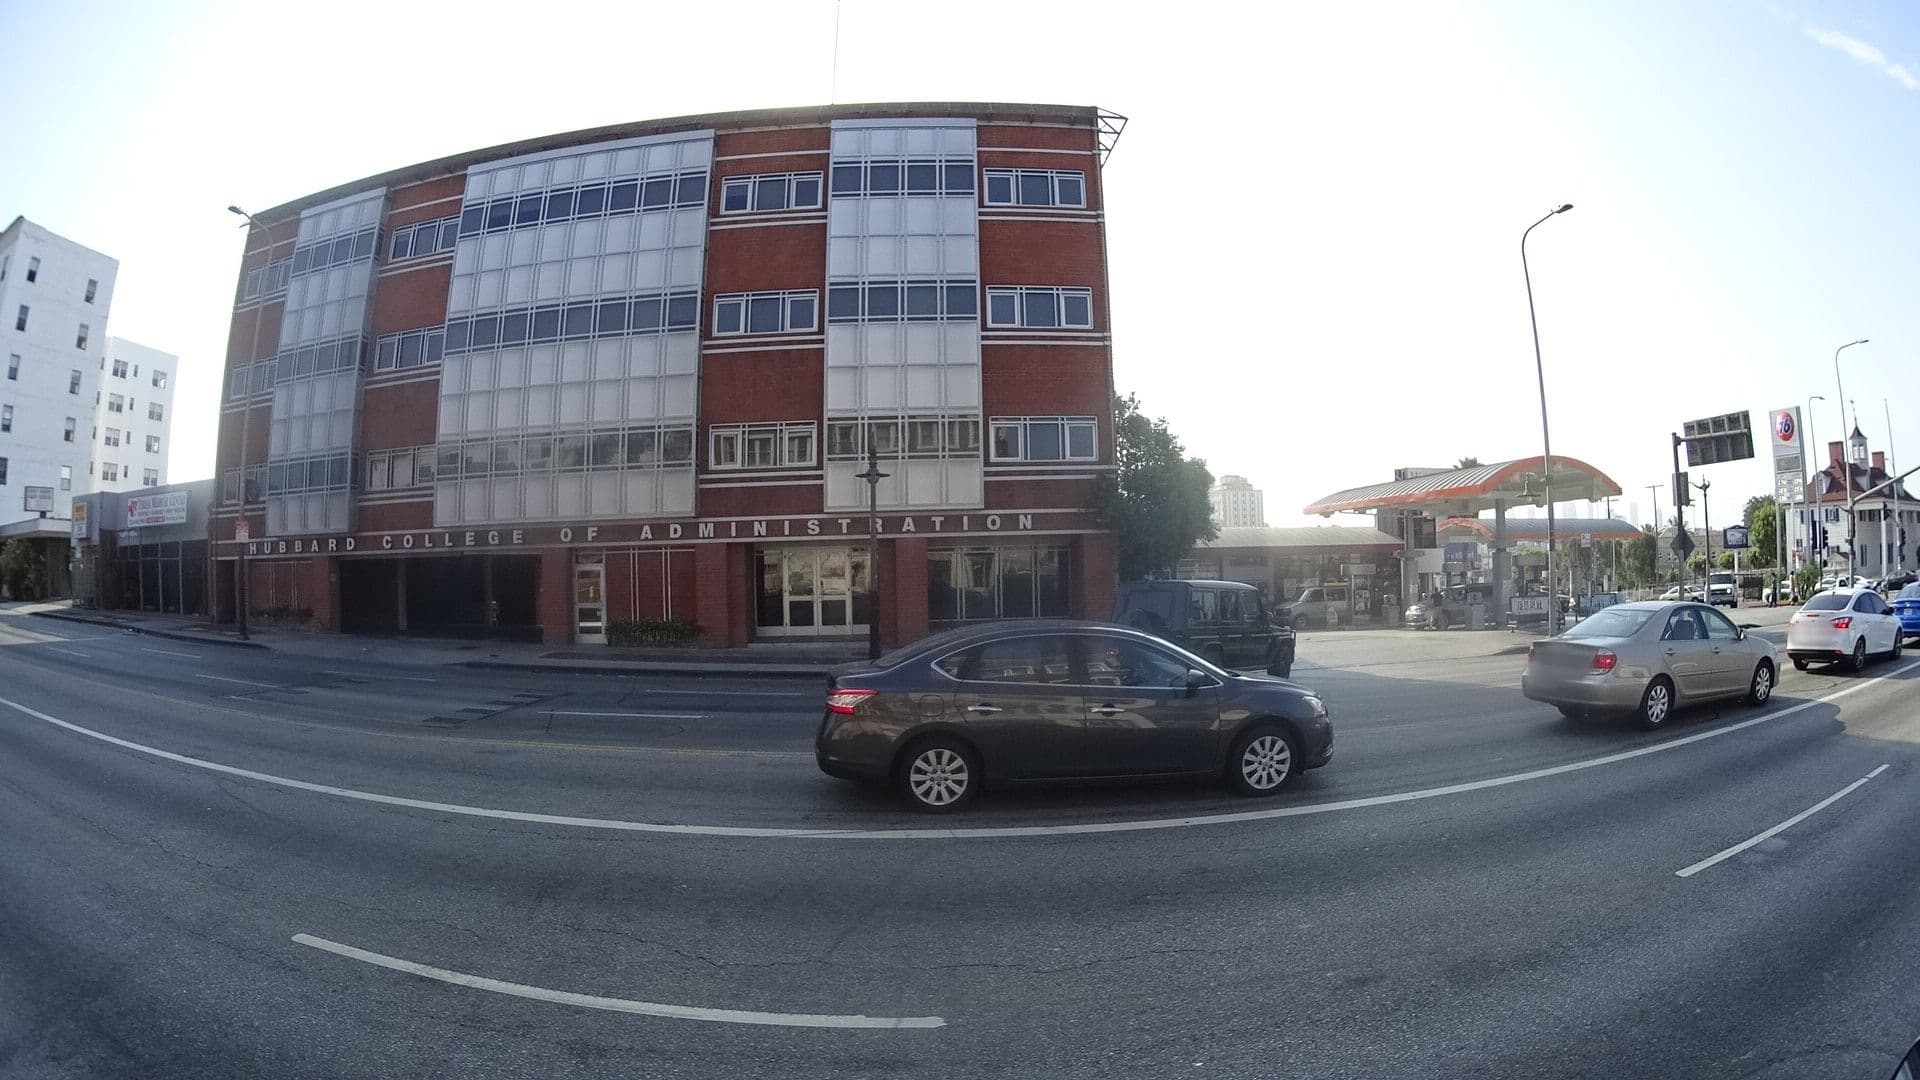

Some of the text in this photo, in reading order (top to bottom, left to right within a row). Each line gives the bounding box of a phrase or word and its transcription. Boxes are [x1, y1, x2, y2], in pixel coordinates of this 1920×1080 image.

[1778, 418, 1791, 434] 76
[249, 513, 1033, 555] HUBBARD COLLEGE OF ADMINISTRATION
